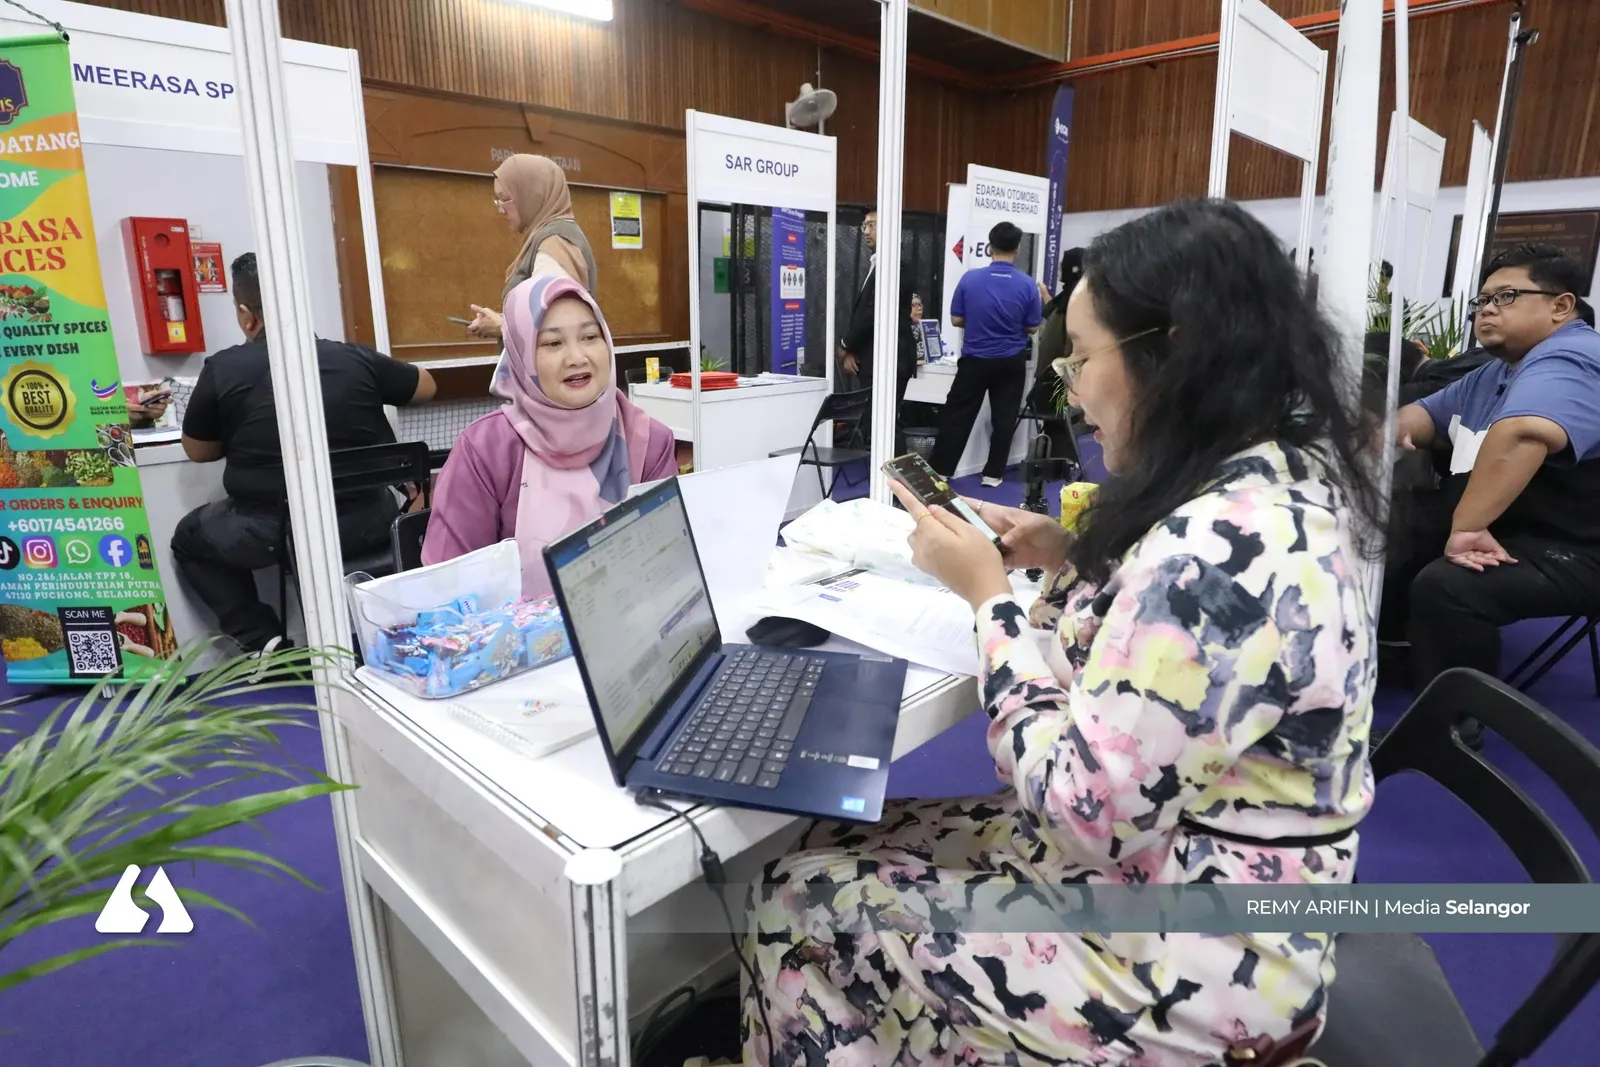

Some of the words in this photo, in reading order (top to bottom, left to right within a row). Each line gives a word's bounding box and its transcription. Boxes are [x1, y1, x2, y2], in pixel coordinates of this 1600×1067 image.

[73, 63, 200, 96] MEERASA
[205, 82, 234, 100] SP
[725, 154, 752, 172] SAR
[756, 159, 799, 177] GROUP
[976, 183, 1005, 198] EDARAN
[1007, 189, 1040, 203] OTOMOBIL
[974, 198, 1010, 211] NASIONAL
[1012, 203, 1038, 214] BERHAD
[0, 217, 83, 244] RASA
[3, 323, 60, 340] QUALITY
[63, 320, 108, 335] SPICES
[3, 344, 43, 358] EVERY
[46, 342, 79, 356] DISH
[26, 382, 45, 390] 100%
[22, 390, 51, 405] BEST
[25, 404, 54, 414] QUALITY
[9, 498, 65, 511] ORDERS
[68, 497, 79, 509] &
[81, 496, 143, 510] ENQUIRY
[8, 516, 125, 532] +60174541266
[96, 572, 116, 580] TPP
[34, 581, 124, 591] PERINDUSTRIAN
[5, 592, 32, 600] 47130
[65, 610, 89, 619] SCAN
[91, 610, 106, 618] ME
